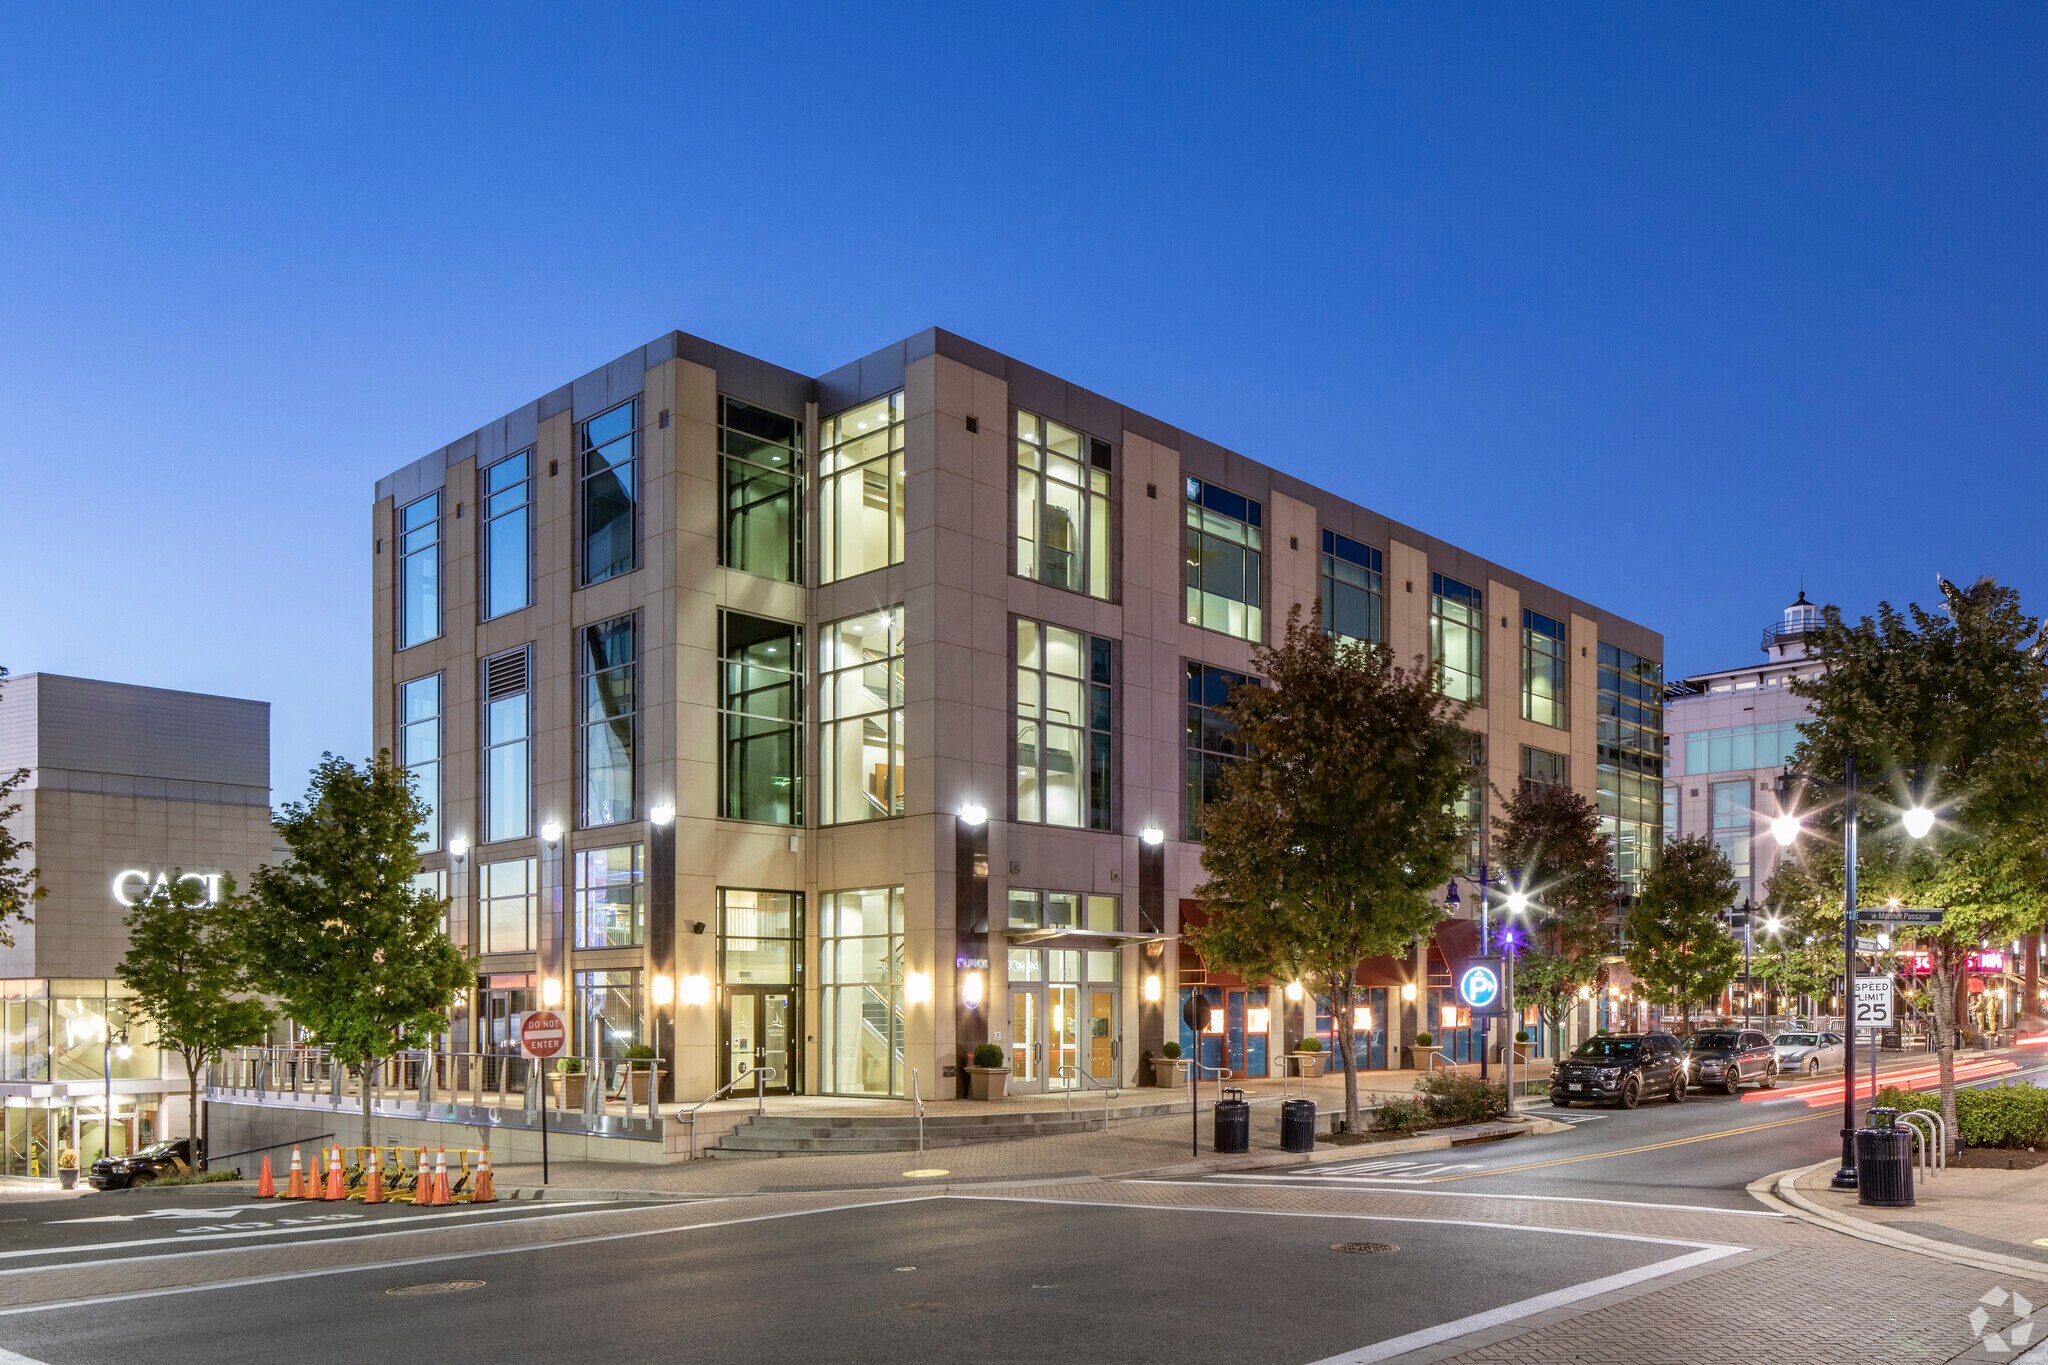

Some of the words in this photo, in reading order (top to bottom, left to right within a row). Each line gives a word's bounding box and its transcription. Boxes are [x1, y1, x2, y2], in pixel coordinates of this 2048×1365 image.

[1878, 912, 1902, 920] Mariner
[1903, 912, 1930, 921] Passage
[1855, 983, 1889, 991] SPEED
[1858, 993, 1884, 1001] LIMIT
[1857, 1003, 1887, 1021] 25
[528, 1020, 540, 1029] DO
[543, 1019, 559, 1028] NOT
[531, 1040, 559, 1049] ENTER
